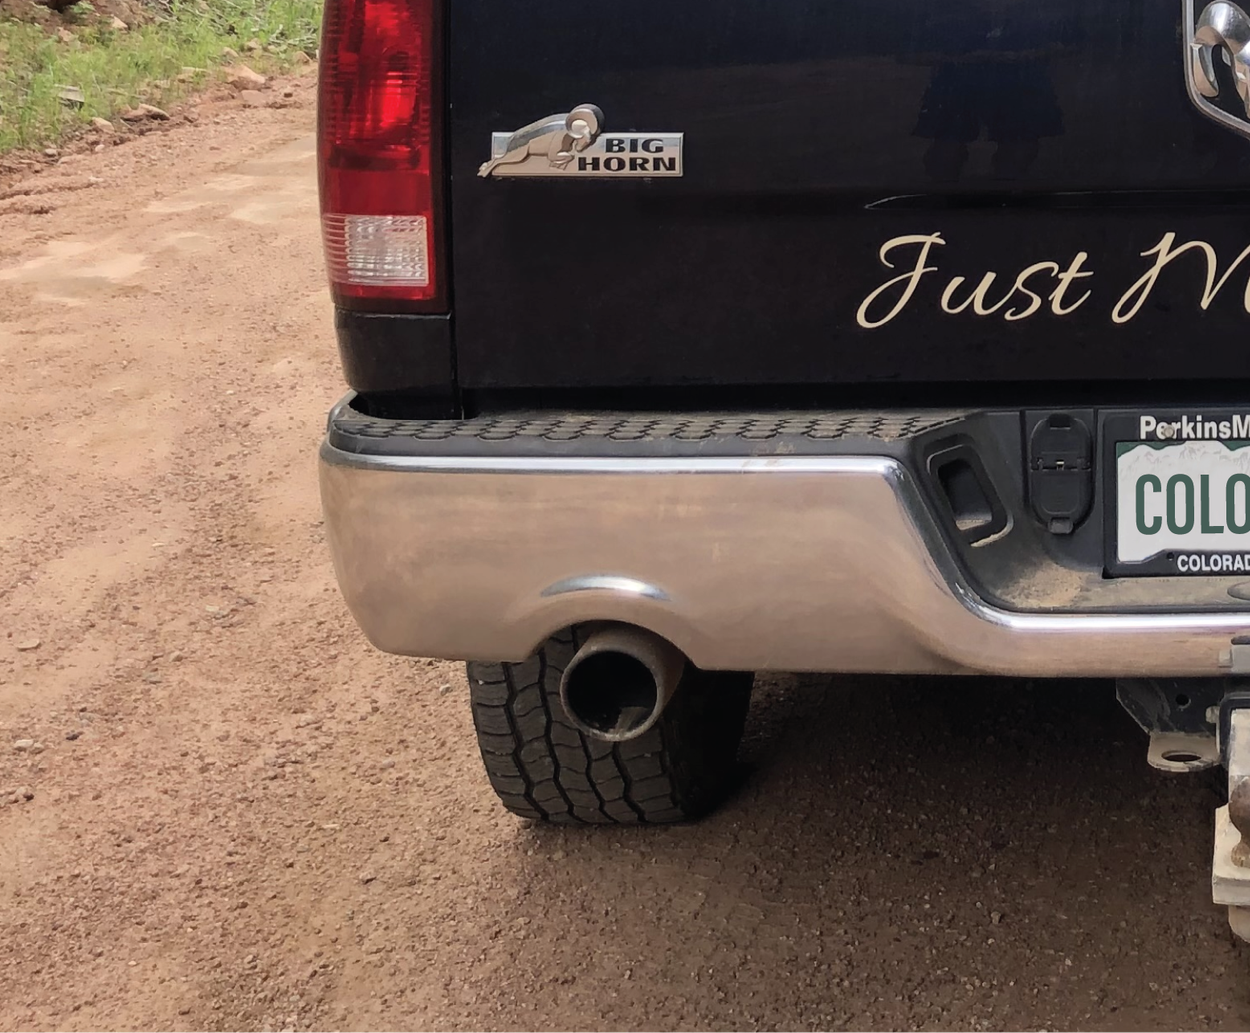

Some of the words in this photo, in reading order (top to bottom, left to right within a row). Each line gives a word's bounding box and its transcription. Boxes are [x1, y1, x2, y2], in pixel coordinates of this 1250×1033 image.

[605, 138, 664, 154] BIG
[577, 156, 677, 172] HORN
[856, 231, 1094, 329] Just
